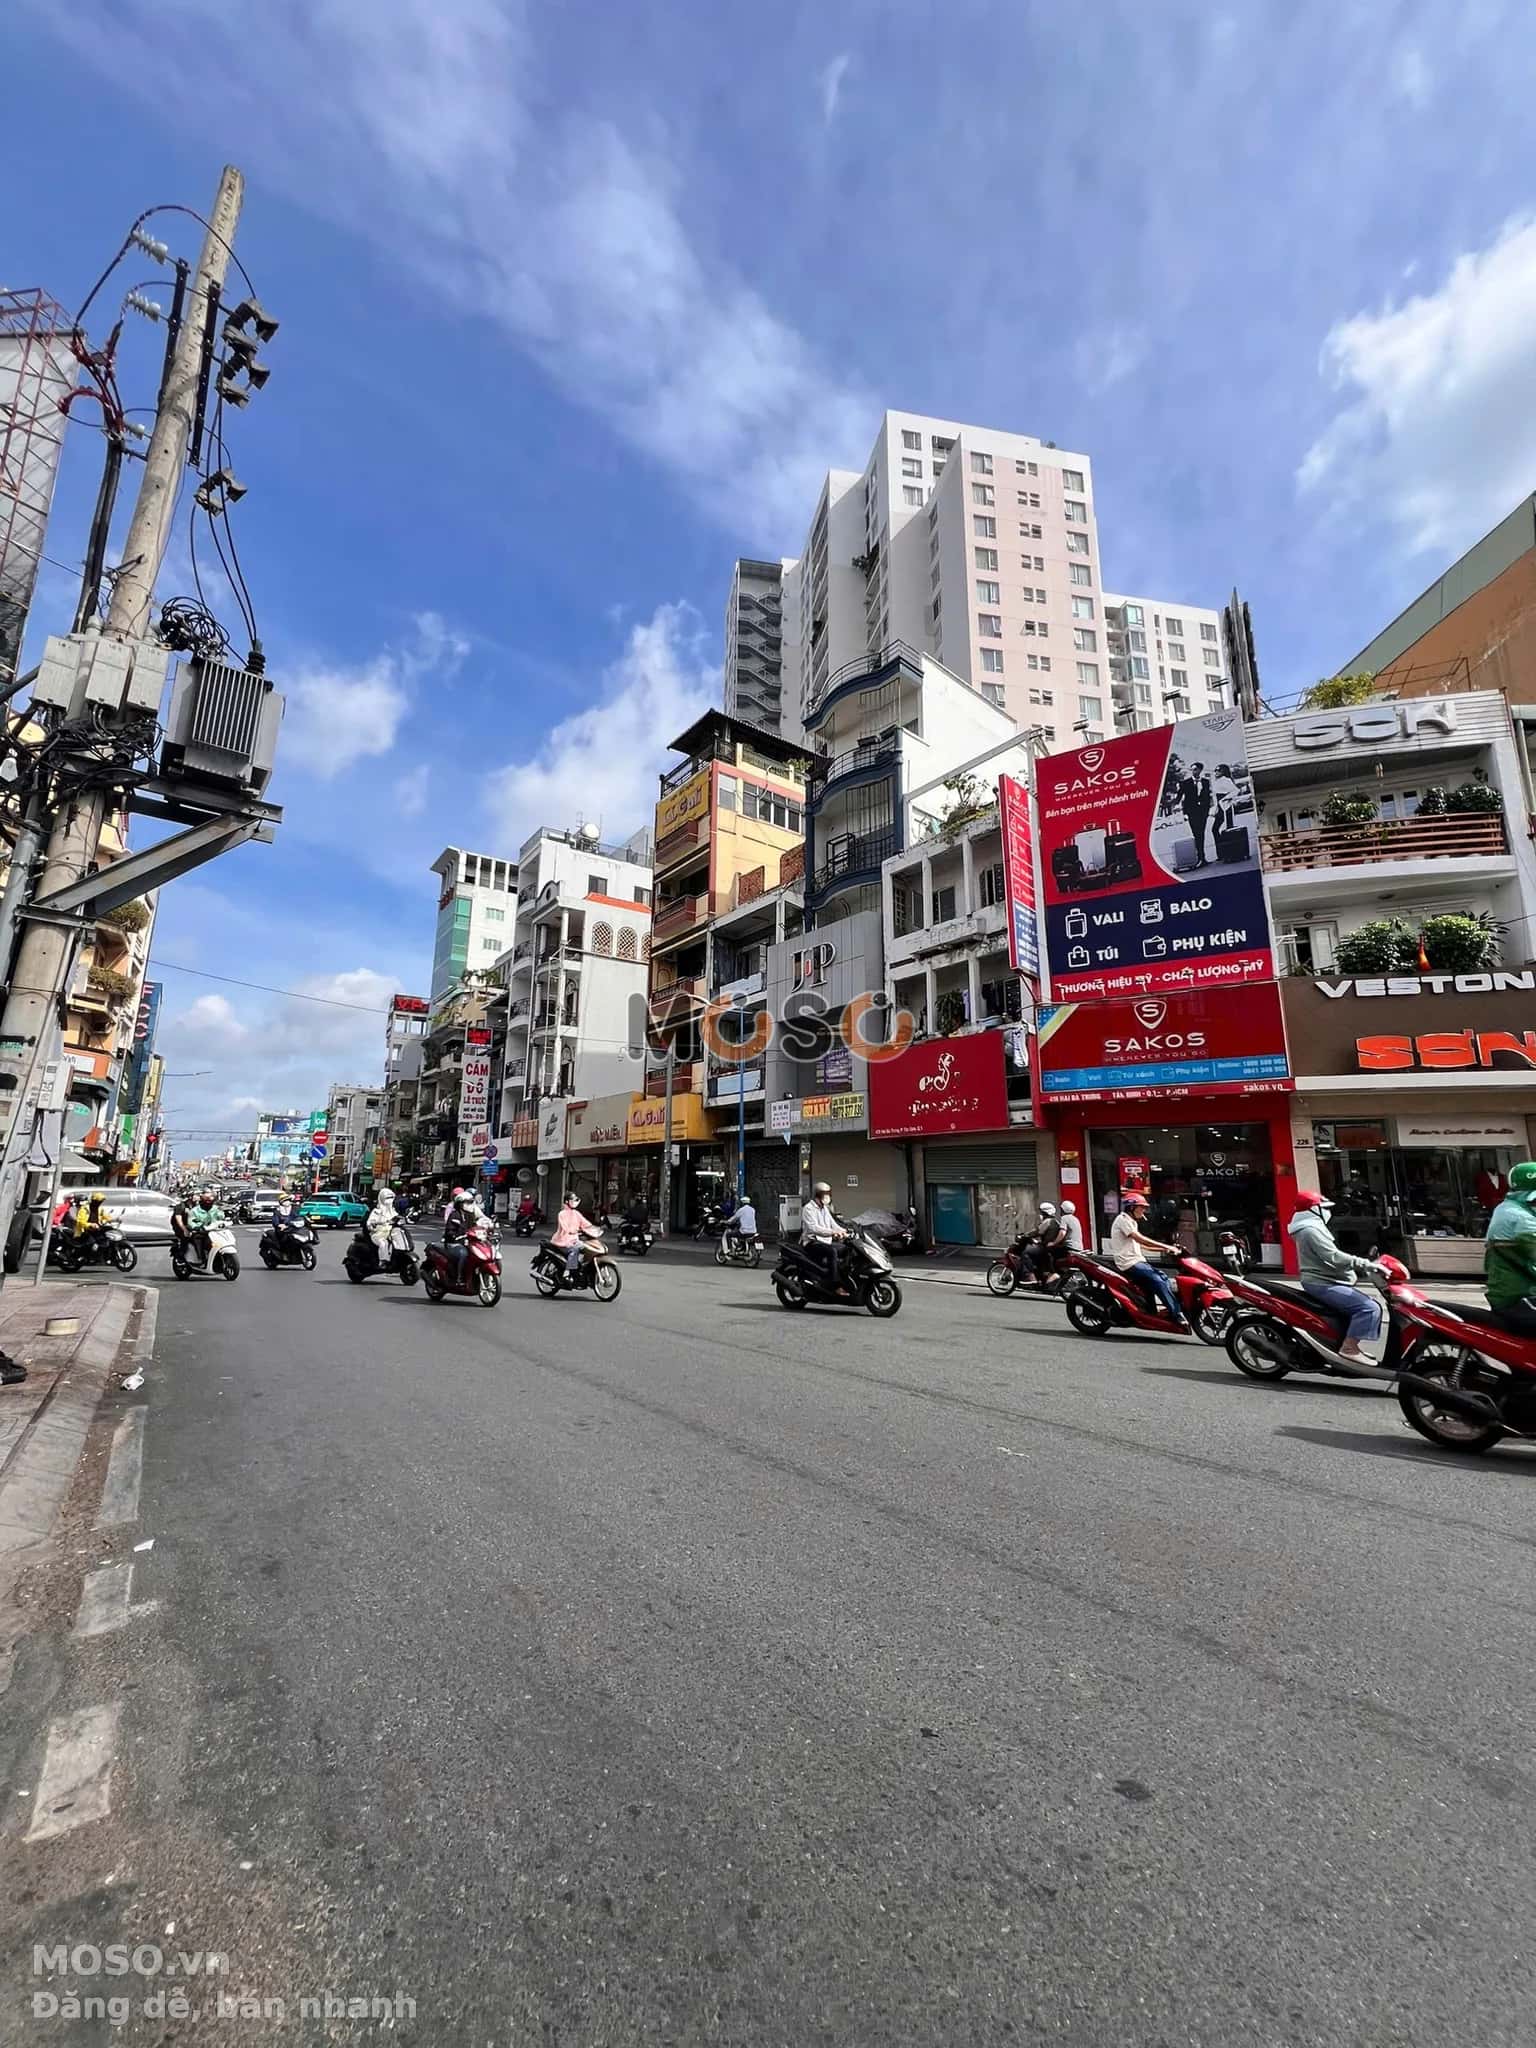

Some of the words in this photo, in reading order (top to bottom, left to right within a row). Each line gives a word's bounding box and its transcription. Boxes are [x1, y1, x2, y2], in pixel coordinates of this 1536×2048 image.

[1054, 766, 1136, 795] SAKOS
[1045, 808, 1060, 819] Bên
[1061, 806, 1076, 816] bạn
[1076, 801, 1093, 811] trên
[1093, 798, 1108, 809] mọi
[1108, 793, 1129, 804] hành
[1130, 788, 1149, 800] trình
[1169, 897, 1213, 915] BALO
[1092, 911, 1125, 926] VALI
[1172, 935, 1205, 951] PHỤ
[1209, 929, 1247, 947] KIỆN
[1096, 945, 1119, 961] TÚI
[1107, 976, 1133, 989] HIỆU
[1197, 964, 1242, 978] LƯỢNG
[1315, 971, 1535, 998] VESTON
[1104, 1032, 1206, 1053] SAKOS
